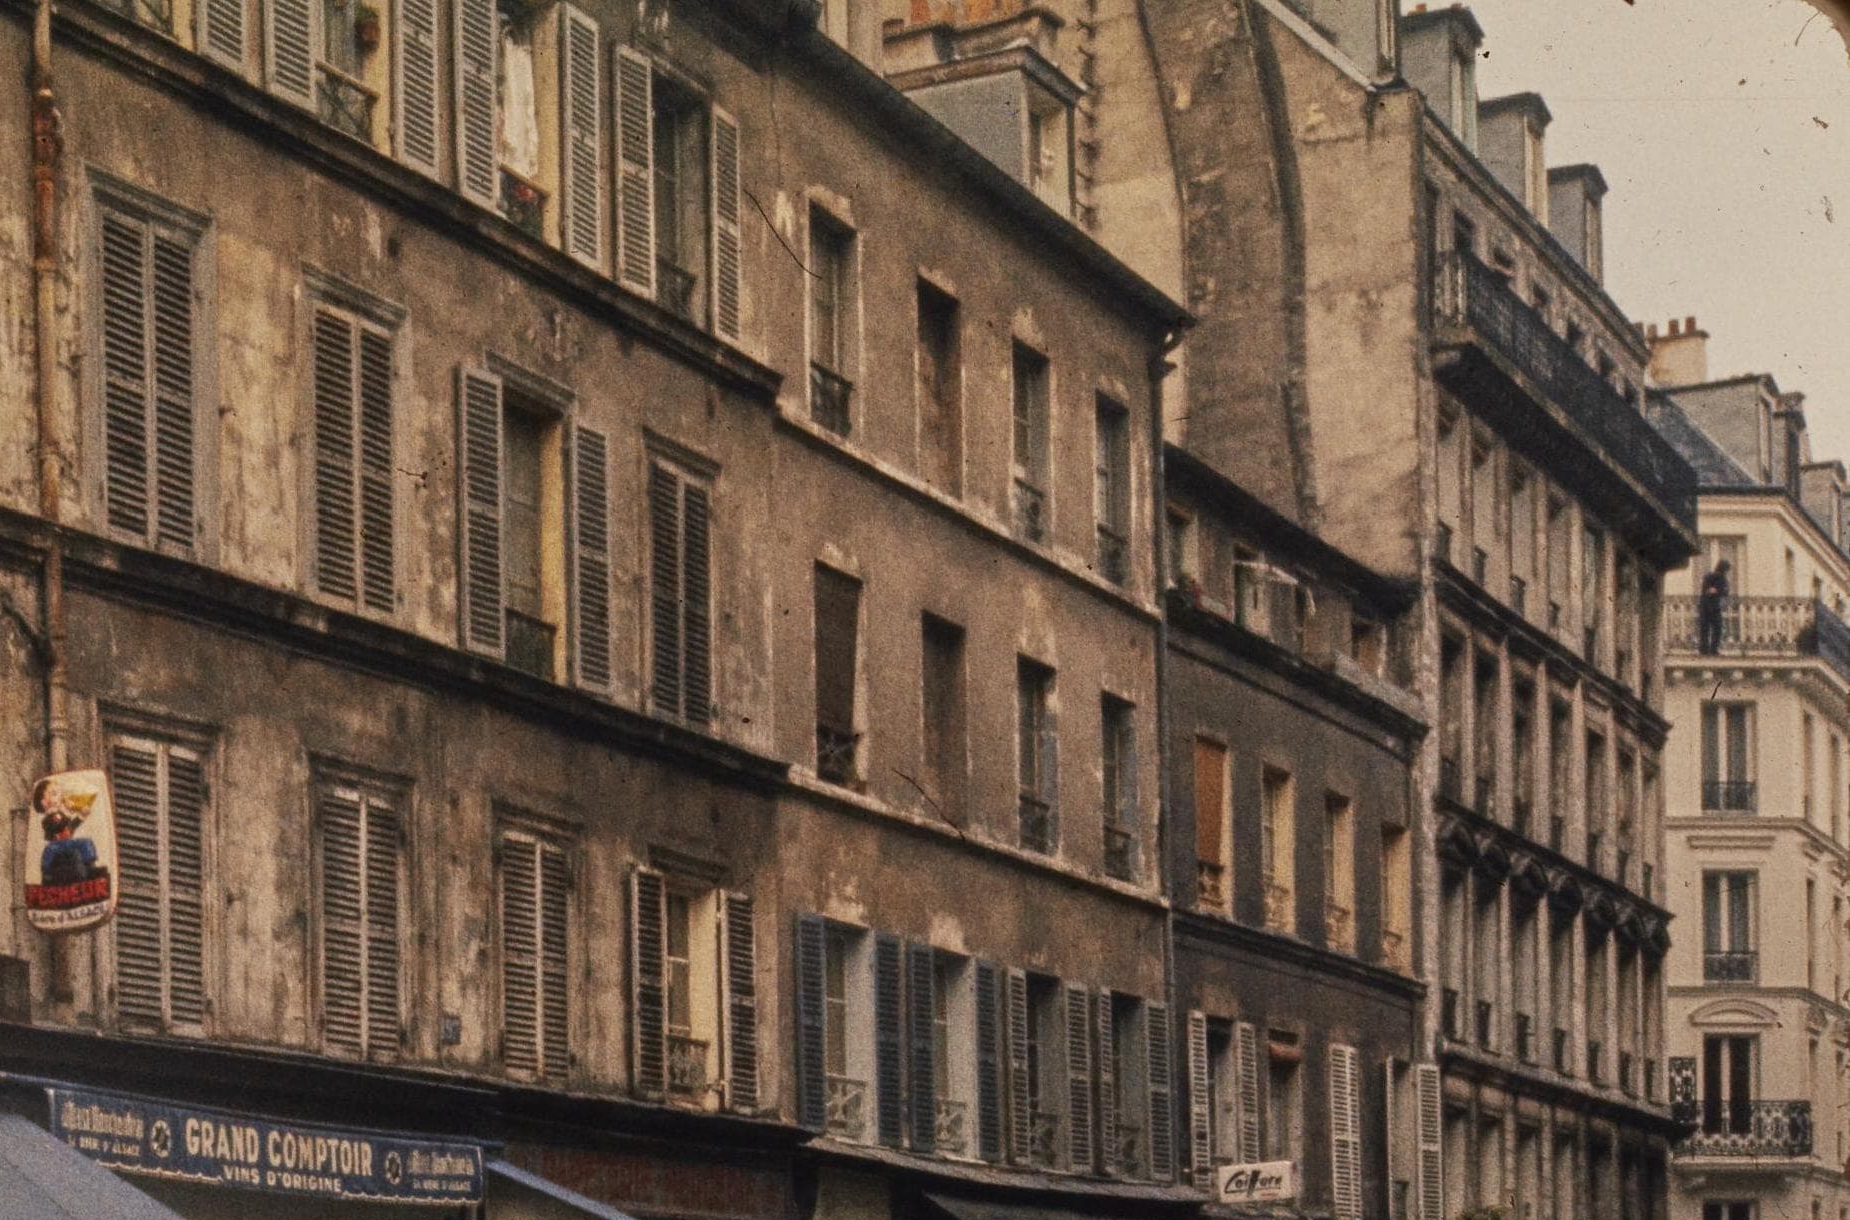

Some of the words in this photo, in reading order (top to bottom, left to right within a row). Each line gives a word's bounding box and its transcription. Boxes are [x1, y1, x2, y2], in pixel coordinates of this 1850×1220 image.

[185, 1117, 260, 1164] GRAND
[267, 1130, 373, 1177] COMPTOIR
[223, 1165, 260, 1185] VINS
[266, 1170, 343, 1193] D'ORIGINE
